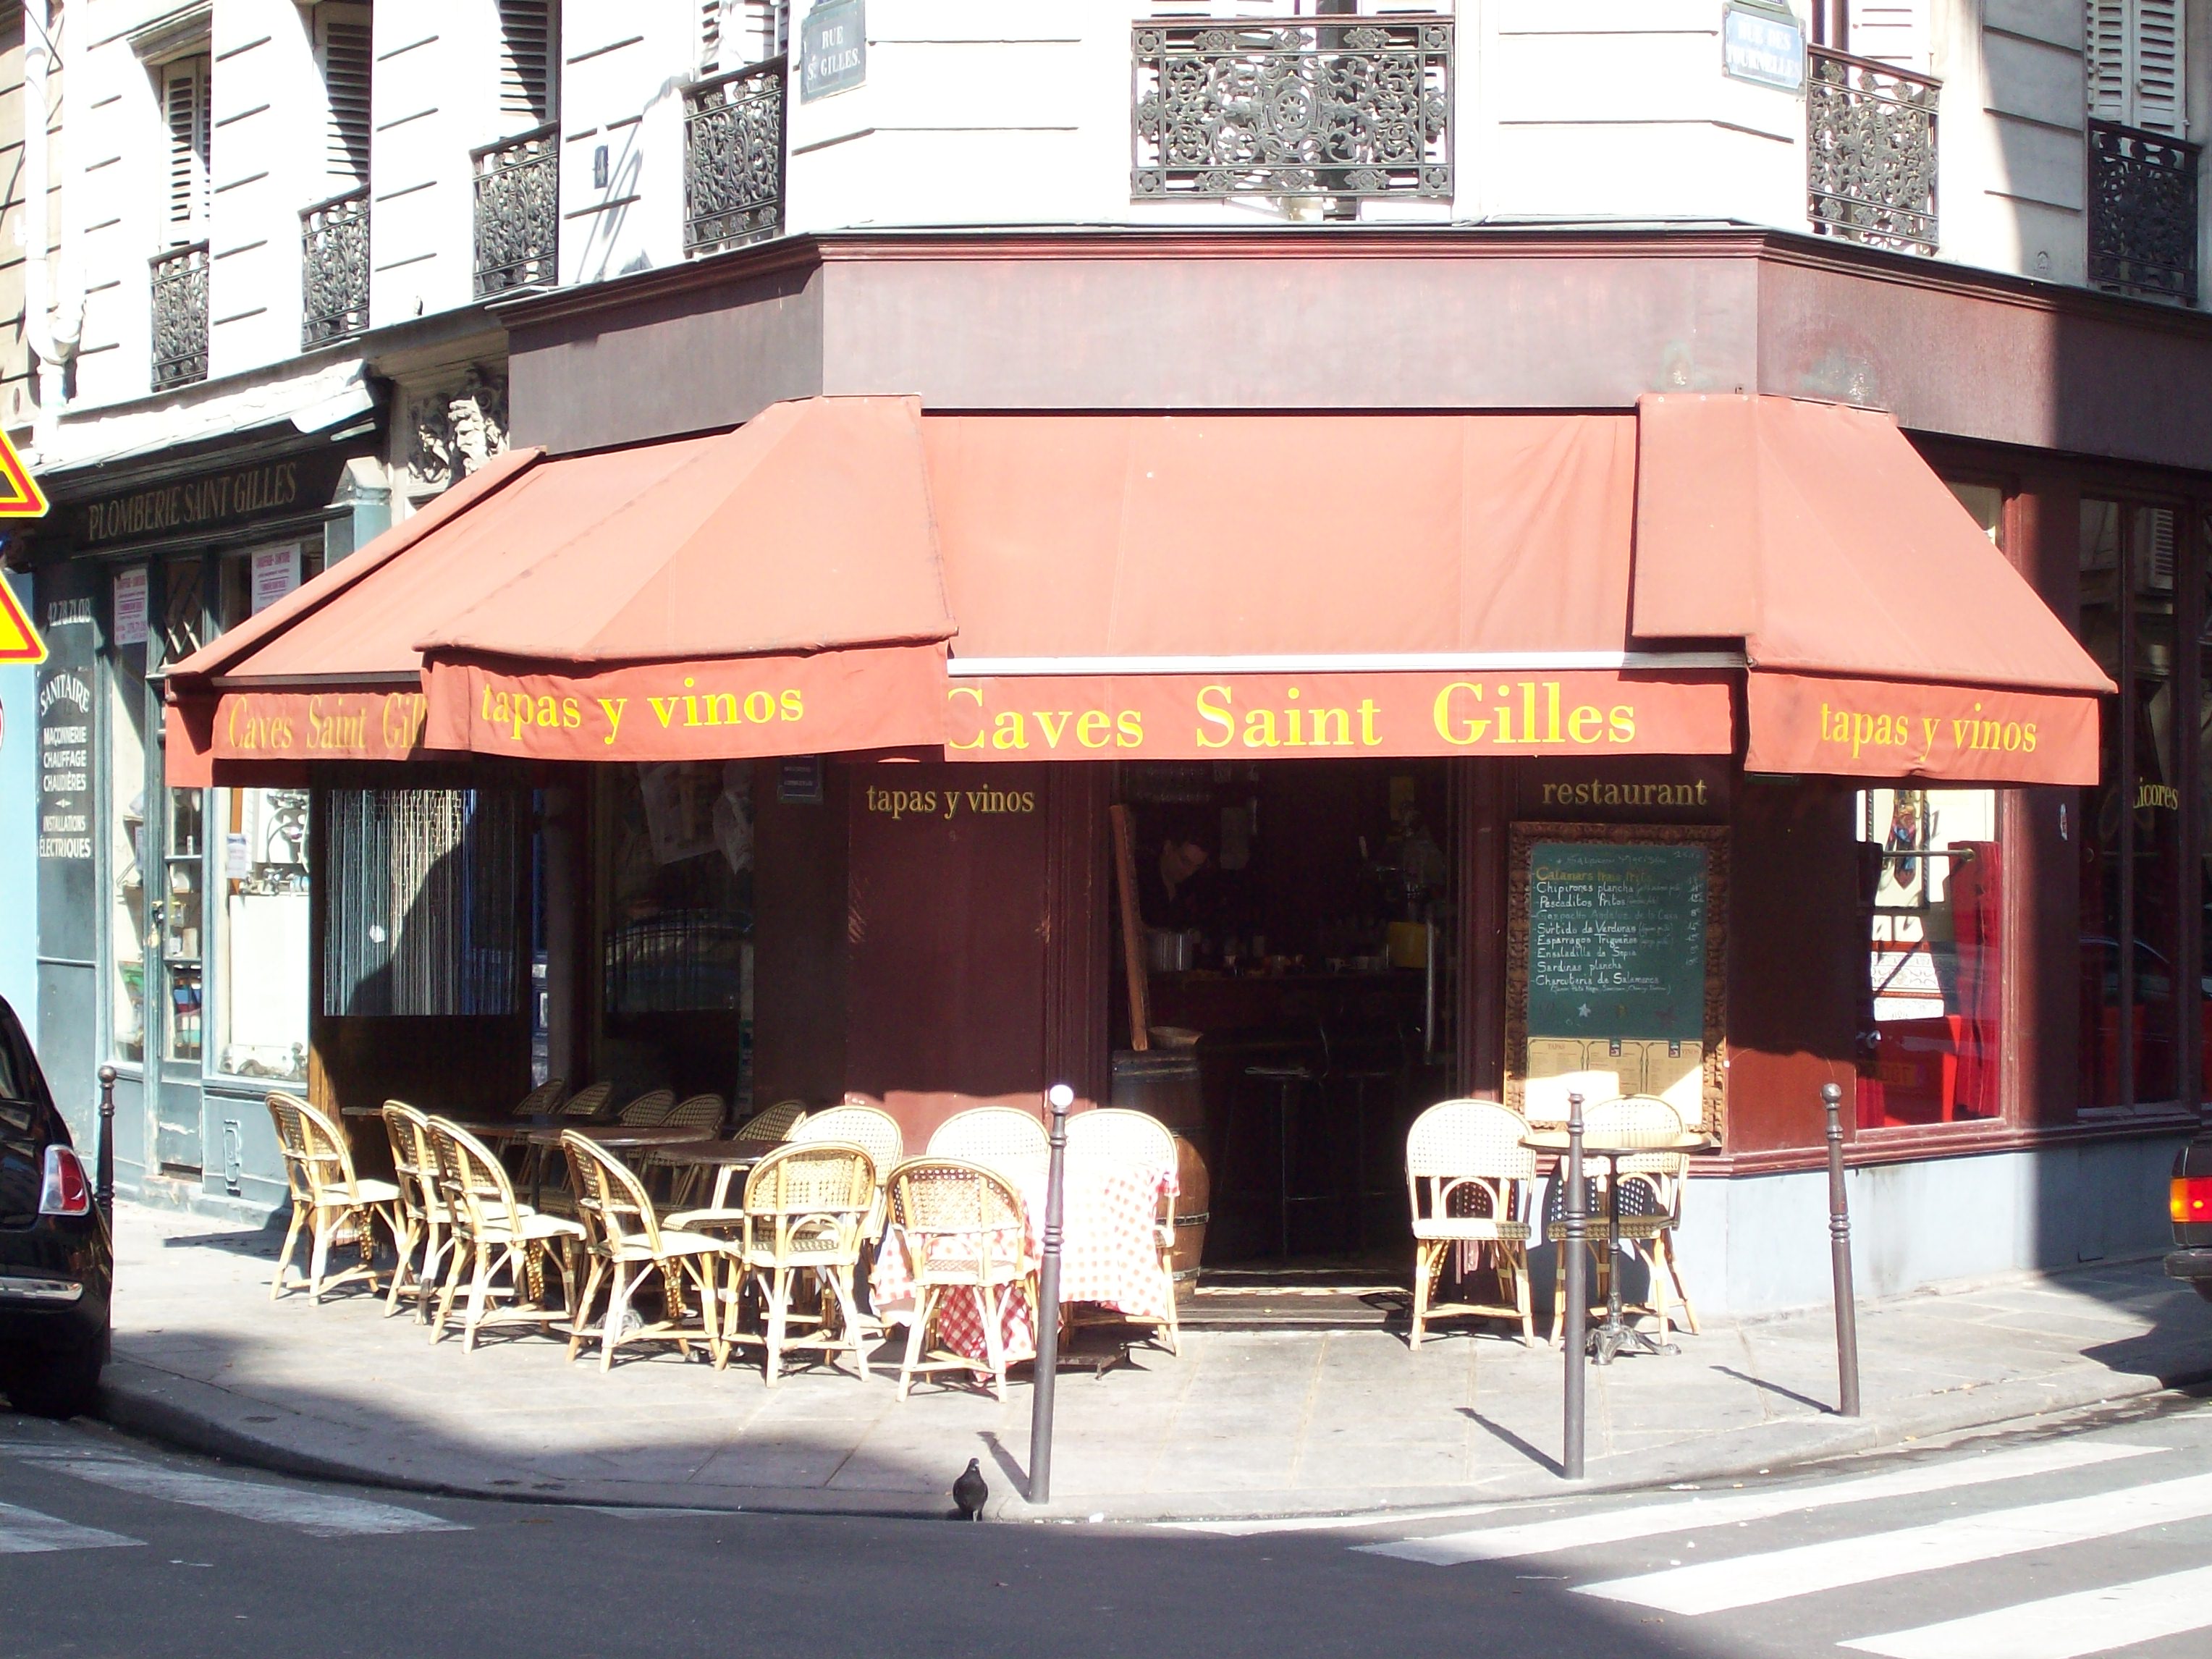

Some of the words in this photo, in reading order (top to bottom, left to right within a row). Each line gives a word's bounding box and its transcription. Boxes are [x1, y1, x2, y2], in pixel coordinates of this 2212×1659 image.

[822, 26, 843, 49] RUE
[88, 486, 180, 541] PLOMBERIE
[183, 476, 231, 523] SAINT
[233, 462, 297, 512] GILLES
[41, 674, 90, 717] SANITAIRE
[229, 696, 292, 749] Caves
[306, 693, 368, 749] Saint
[481, 683, 581, 740] tapas
[597, 697, 628, 745] y
[646, 677, 804, 727] vinos
[947, 687, 1144, 750] Caves
[1196, 684, 1384, 748] Saint
[1433, 681, 1637, 746] Gilles
[43, 726, 88, 746] MAÇONNERIE
[1820, 702, 1909, 759] tapas
[1920, 717, 1941, 762] y
[1951, 702, 2038, 753] vinos
[43, 750, 87, 768] CHAUFFAGE
[43, 771, 86, 792] CHAUDIÈRES
[866, 784, 937, 819] tapas
[943, 788, 961, 819] y
[966, 783, 1036, 813] vinos
[1542, 779, 1708, 806] restaurant
[43, 815, 85, 832] INSTALLATIONS
[1536, 880, 1594, 900] Chipirones
[1597, 880, 1634, 899] plancha
[1540, 893, 1592, 908] Pescaditos
[1599, 892, 1626, 906] fritos
[1537, 921, 1578, 934] Surtido
[1582, 920, 1594, 933] de
[1595, 920, 1637, 934] Verduras
[1537, 934, 1591, 949] Esparragos
[1594, 934, 1637, 947] Trigueños
[1537, 946, 1591, 958] Ensaladilla
[1597, 947, 1606, 957] de
[1612, 947, 1637, 961] Sepia
[1537, 960, 1582, 973] Sardinas
[1589, 957, 1622, 976] plancha
[1535, 973, 1593, 985] Charcuteria
[1597, 971, 1609, 984] de
[1613, 971, 1659, 985] Salamanca
